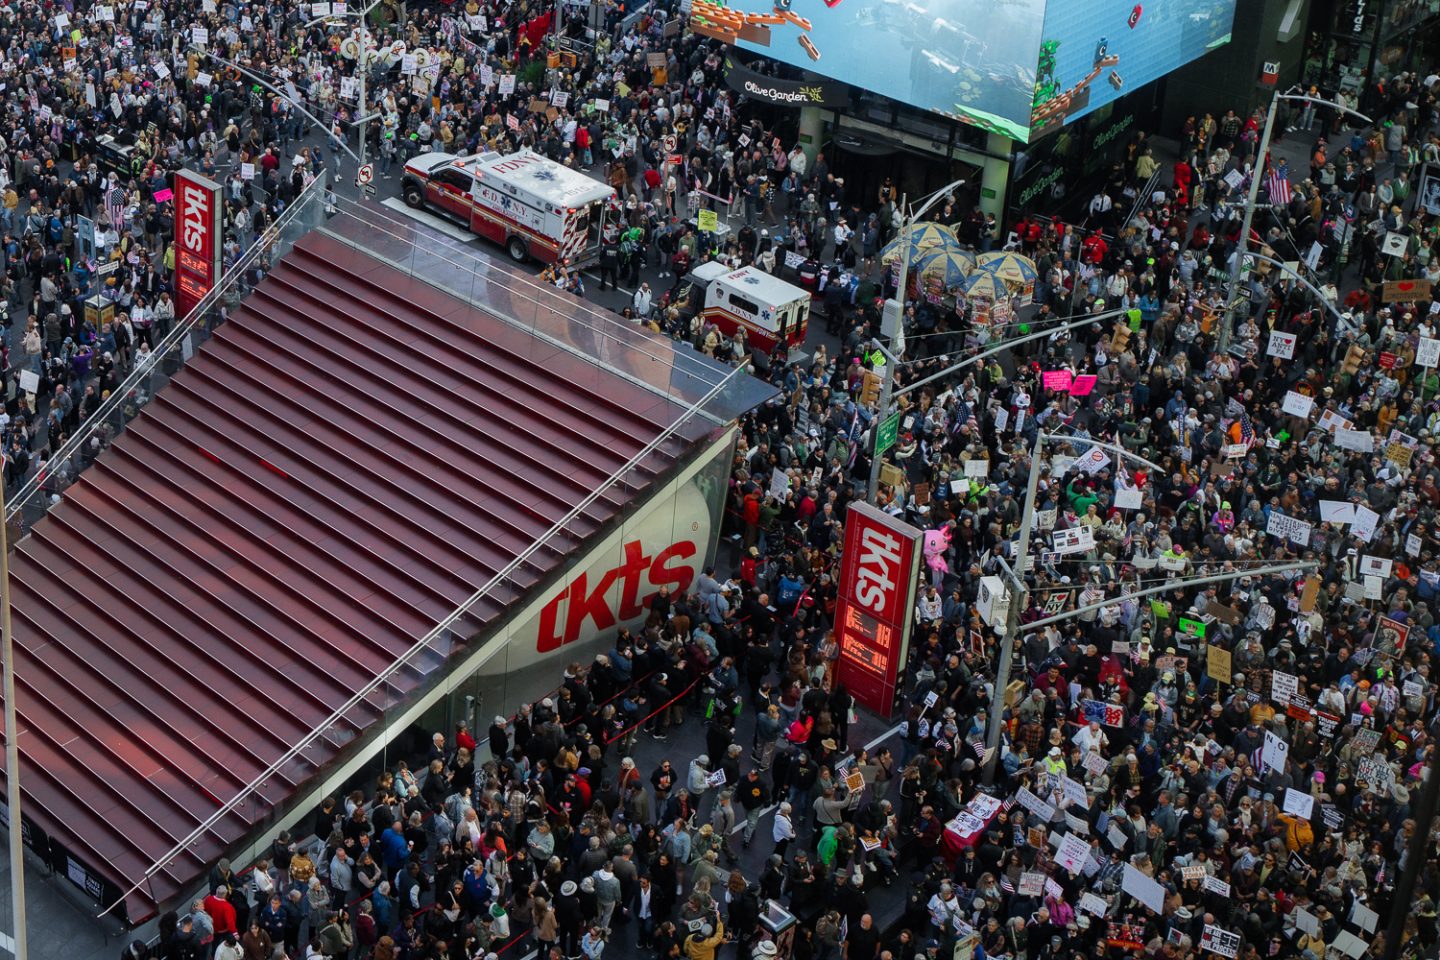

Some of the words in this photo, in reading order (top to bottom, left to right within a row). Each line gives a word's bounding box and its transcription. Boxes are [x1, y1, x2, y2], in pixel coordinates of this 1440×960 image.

[745, 81, 768, 97] Olive
[769, 88, 809, 102] Garden
[491, 151, 542, 174] FDNY
[182, 185, 208, 253] tkts
[727, 269, 750, 280] FDNY
[855, 525, 901, 613] tkts
[536, 538, 697, 654] tkts
[1046, 603, 1062, 611] NY
